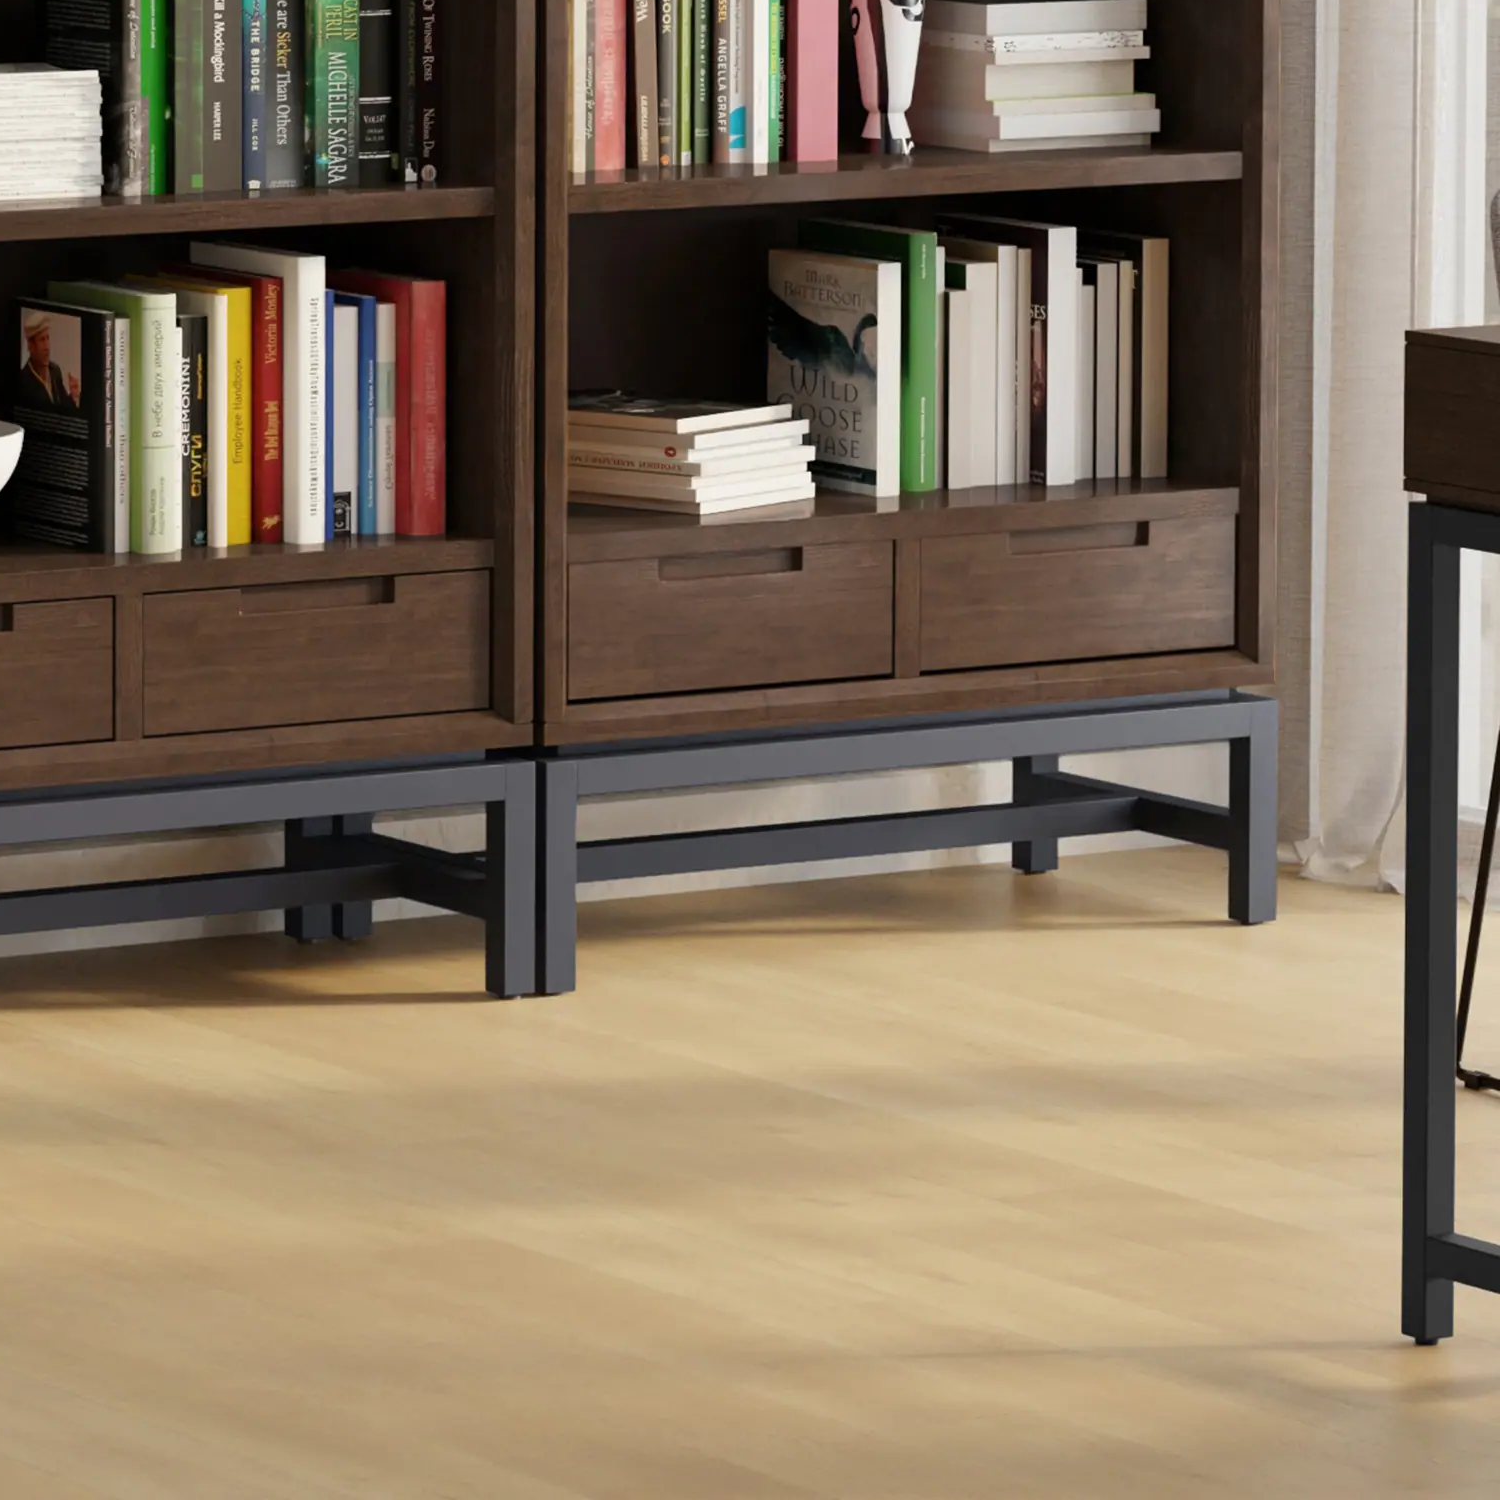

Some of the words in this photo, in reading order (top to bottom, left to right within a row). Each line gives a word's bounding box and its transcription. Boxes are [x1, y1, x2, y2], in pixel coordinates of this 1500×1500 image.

[251, 21, 260, 44] THE
[277, 10, 288, 29] are
[325, 4, 343, 39] PERIL
[344, 28, 358, 40] IN
[211, 21, 224, 83] Mockingbird
[277, 31, 290, 68] Sicker
[718, 38, 726, 90] ANGELLA
[251, 48, 260, 92] BRIDGE
[277, 71, 291, 101] Than
[328, 52, 347, 124] MICHELLE
[213, 102, 221, 128] HARPER
[277, 104, 291, 145] Others
[718, 95, 727, 133] GRAFF
[213, 129, 221, 140] LEE
[328, 128, 347, 184] SAGARA
[265, 284, 279, 320] Mosley
[784, 281, 861, 307] BATTERSON
[152, 320, 163, 368] империй
[265, 324, 277, 364] Victoria
[153, 372, 164, 397] двух
[232, 359, 242, 410] Handbook
[790, 365, 859, 403] WILD
[153, 401, 163, 427] небе
[181, 356, 190, 456] CREMONINI
[152, 430, 162, 438] В
[232, 413, 244, 464] Employee
